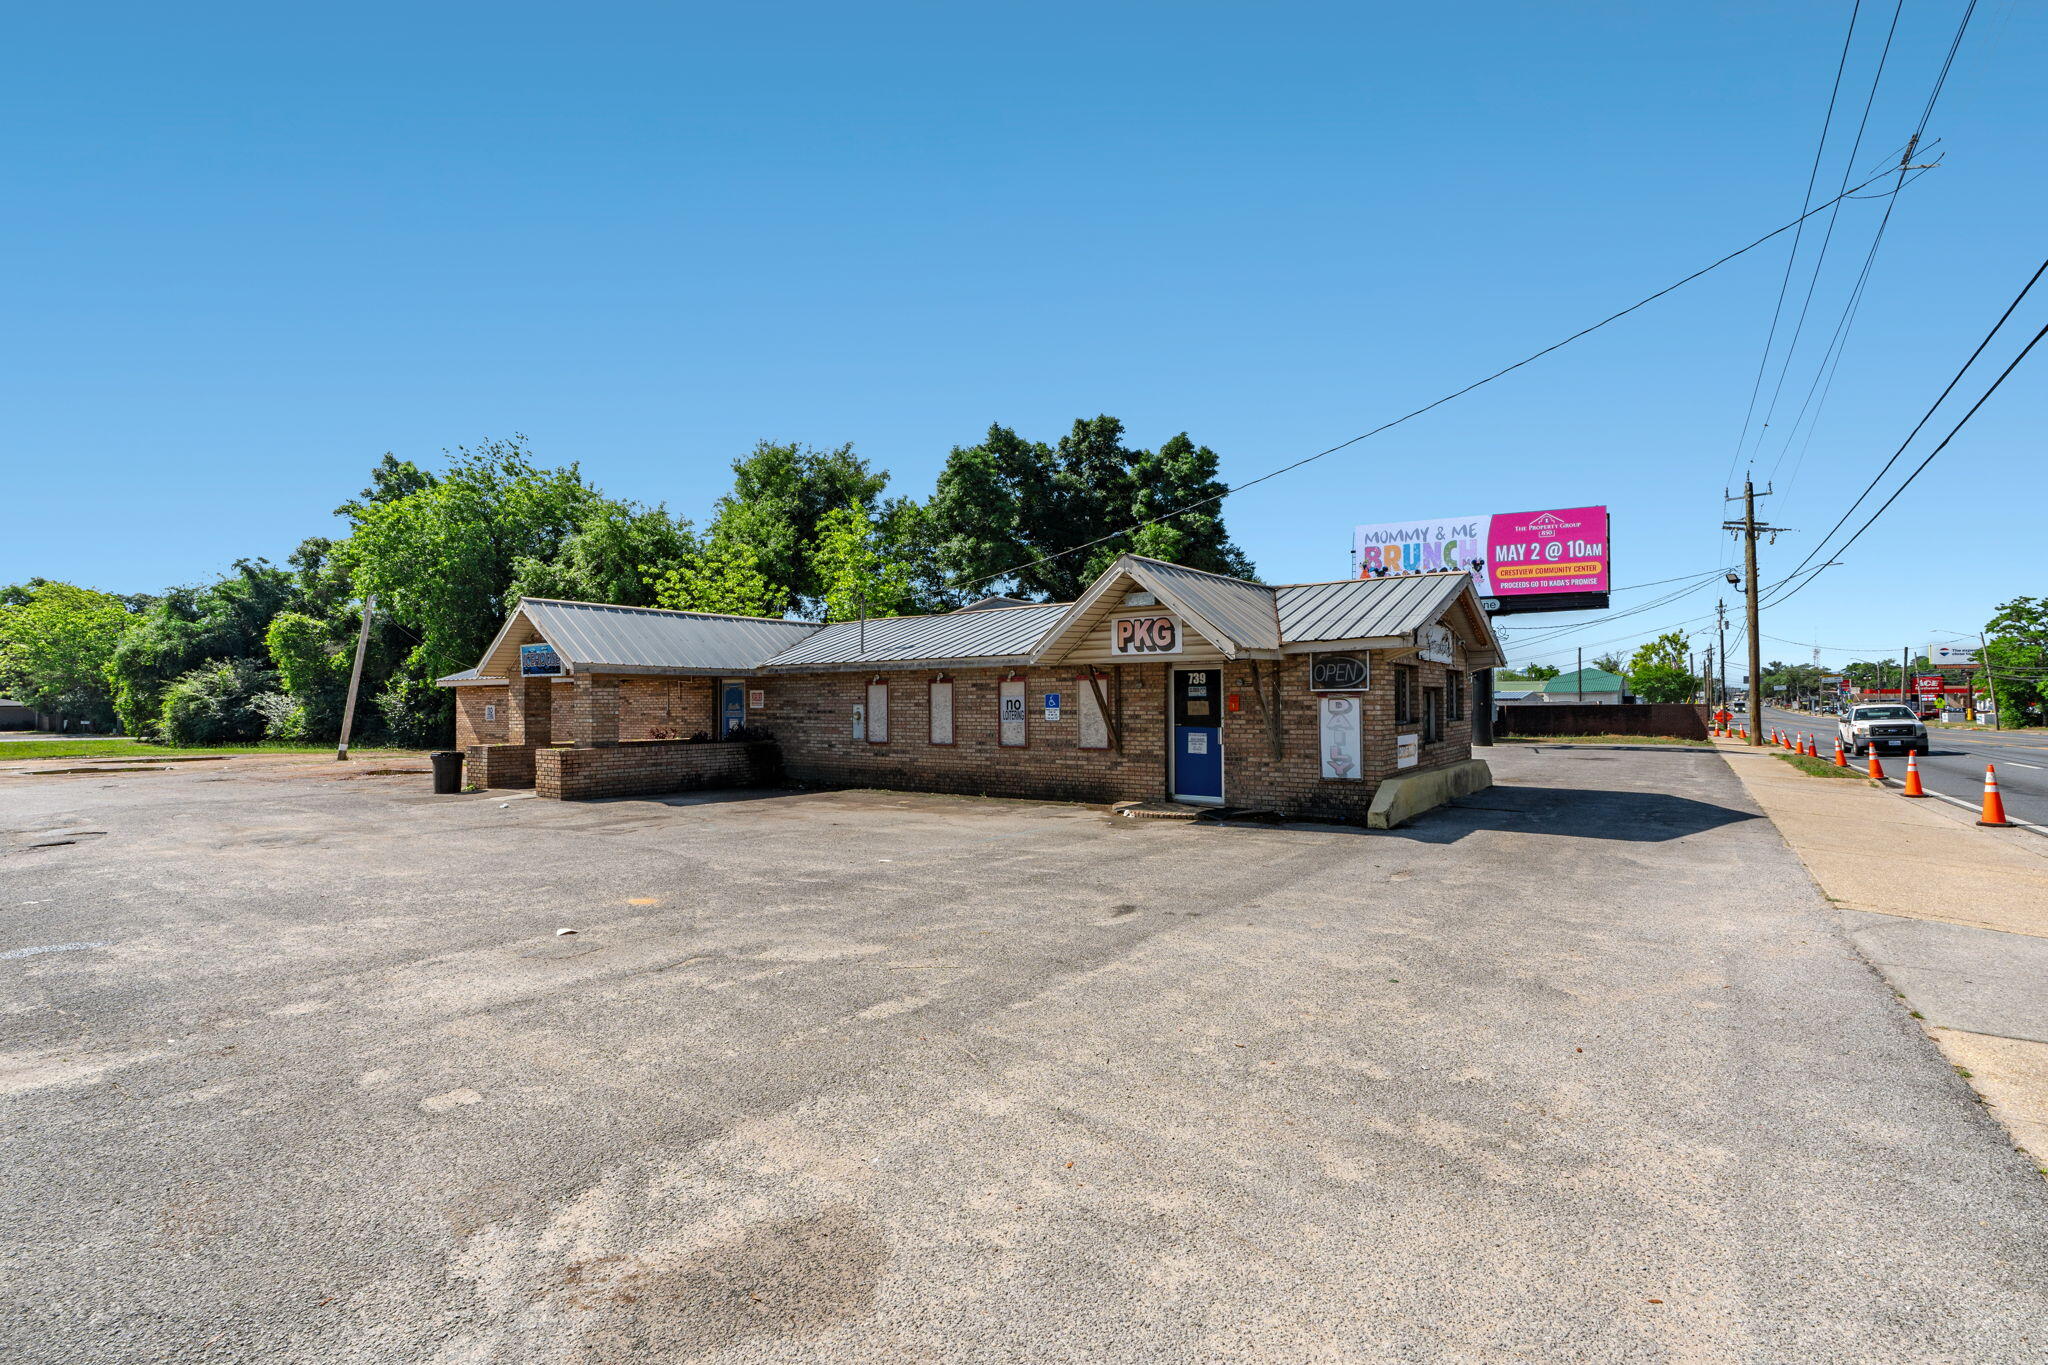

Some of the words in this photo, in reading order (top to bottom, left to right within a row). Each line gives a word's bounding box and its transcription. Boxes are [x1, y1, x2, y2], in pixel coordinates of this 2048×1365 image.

[1365, 526, 1429, 545] MOMMY
[1435, 526, 1446, 540] &
[1451, 522, 1478, 539] ME
[1364, 539, 1478, 571] BRUNCH
[1496, 543, 1526, 562] MAY
[1530, 542, 1540, 560] 2
[1545, 541, 1563, 561] @
[1567, 540, 1602, 558] 10AM
[1500, 568, 1534, 576] CRESTVIEW
[1535, 566, 1572, 575] COMMUNITY
[1573, 564, 1597, 572] CENTER
[1117, 617, 1176, 653] PKG
[1188, 672, 1206, 684] 739
[1314, 663, 1358, 682] OPEN
[1915, 679, 1938, 687] ACE
[1006, 699, 1021, 710] no
[1327, 698, 1355, 777] DAILY
